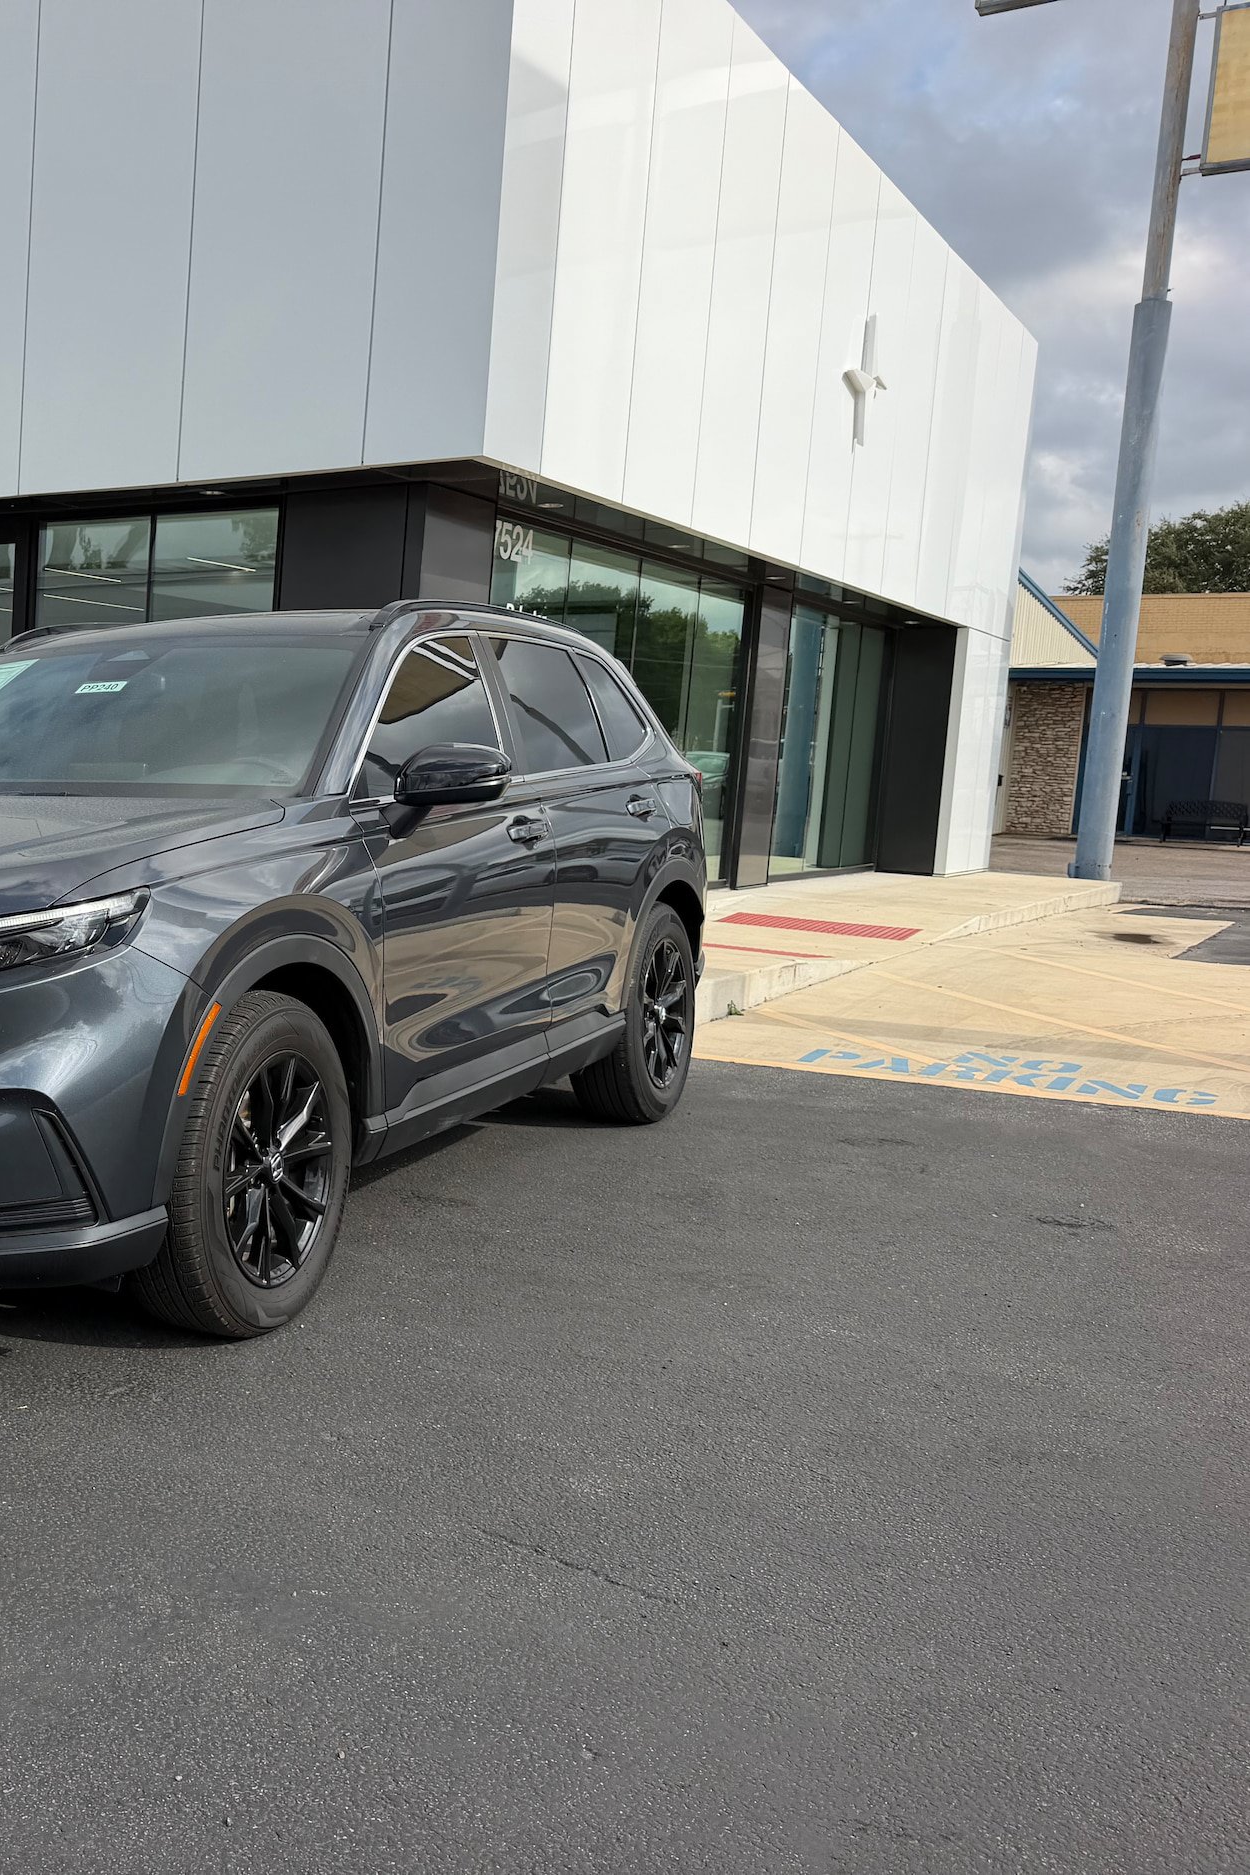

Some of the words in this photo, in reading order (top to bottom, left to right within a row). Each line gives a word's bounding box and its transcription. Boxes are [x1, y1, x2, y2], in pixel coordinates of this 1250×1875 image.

[80, 683, 119, 692] PP240
[952, 1051, 1082, 1073] NO
[796, 1048, 1220, 1105] PARKING
